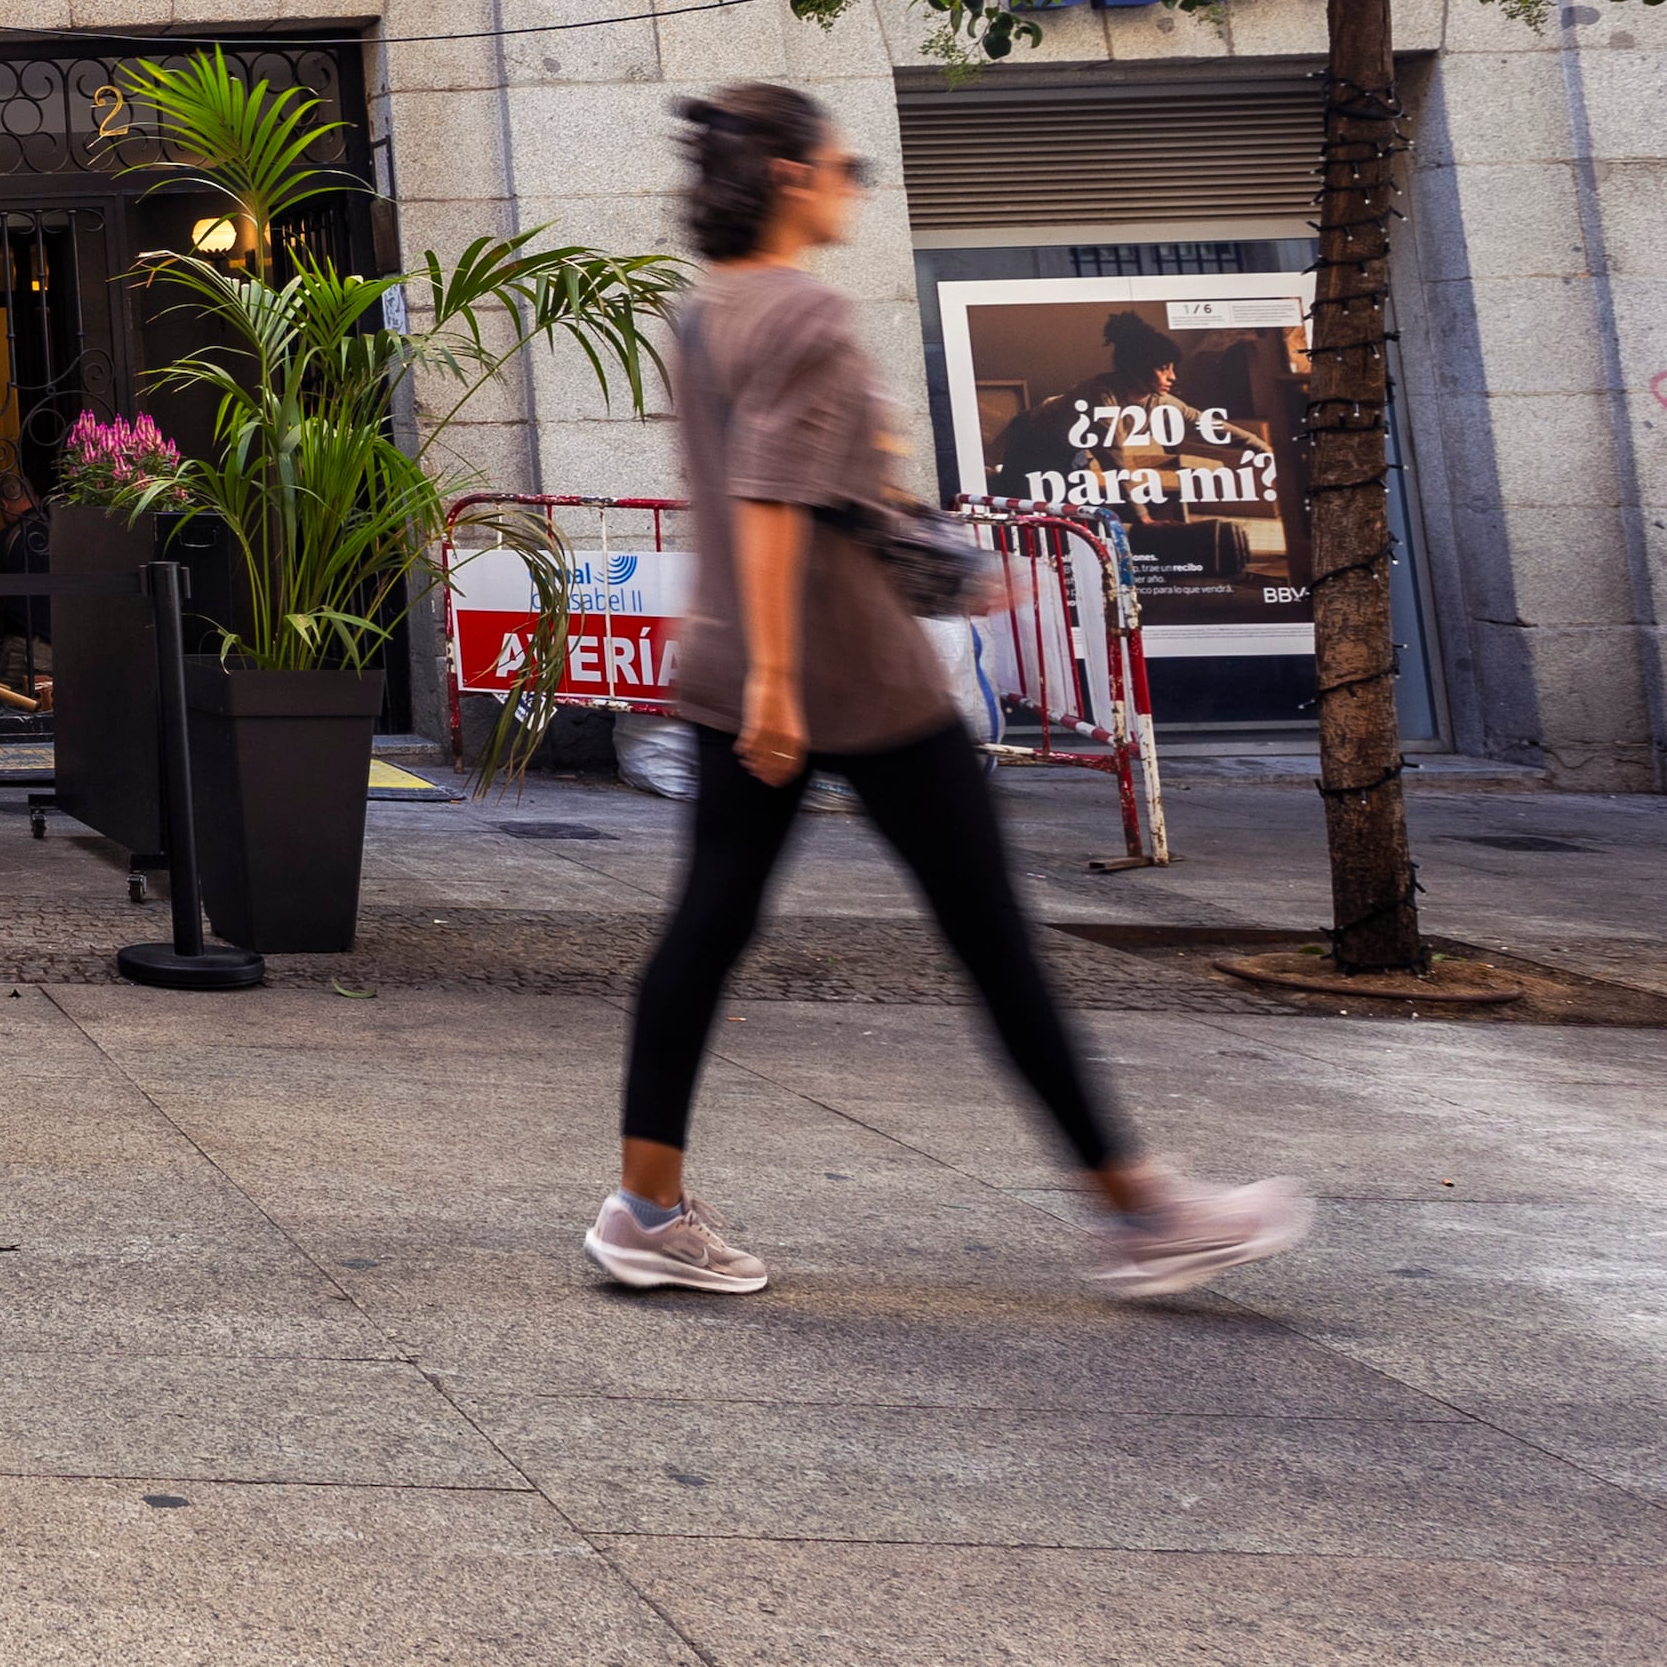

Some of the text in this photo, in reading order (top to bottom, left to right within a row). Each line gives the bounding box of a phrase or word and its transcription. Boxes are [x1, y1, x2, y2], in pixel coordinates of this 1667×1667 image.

[94, 85, 129, 137] 2
[1068, 399, 1232, 448] ¿720 €
[1026, 450, 1278, 506] para mí?
[1153, 587, 1173, 596] para
[1182, 586, 1200, 595] que
[1172, 563, 1204, 572] recibo
